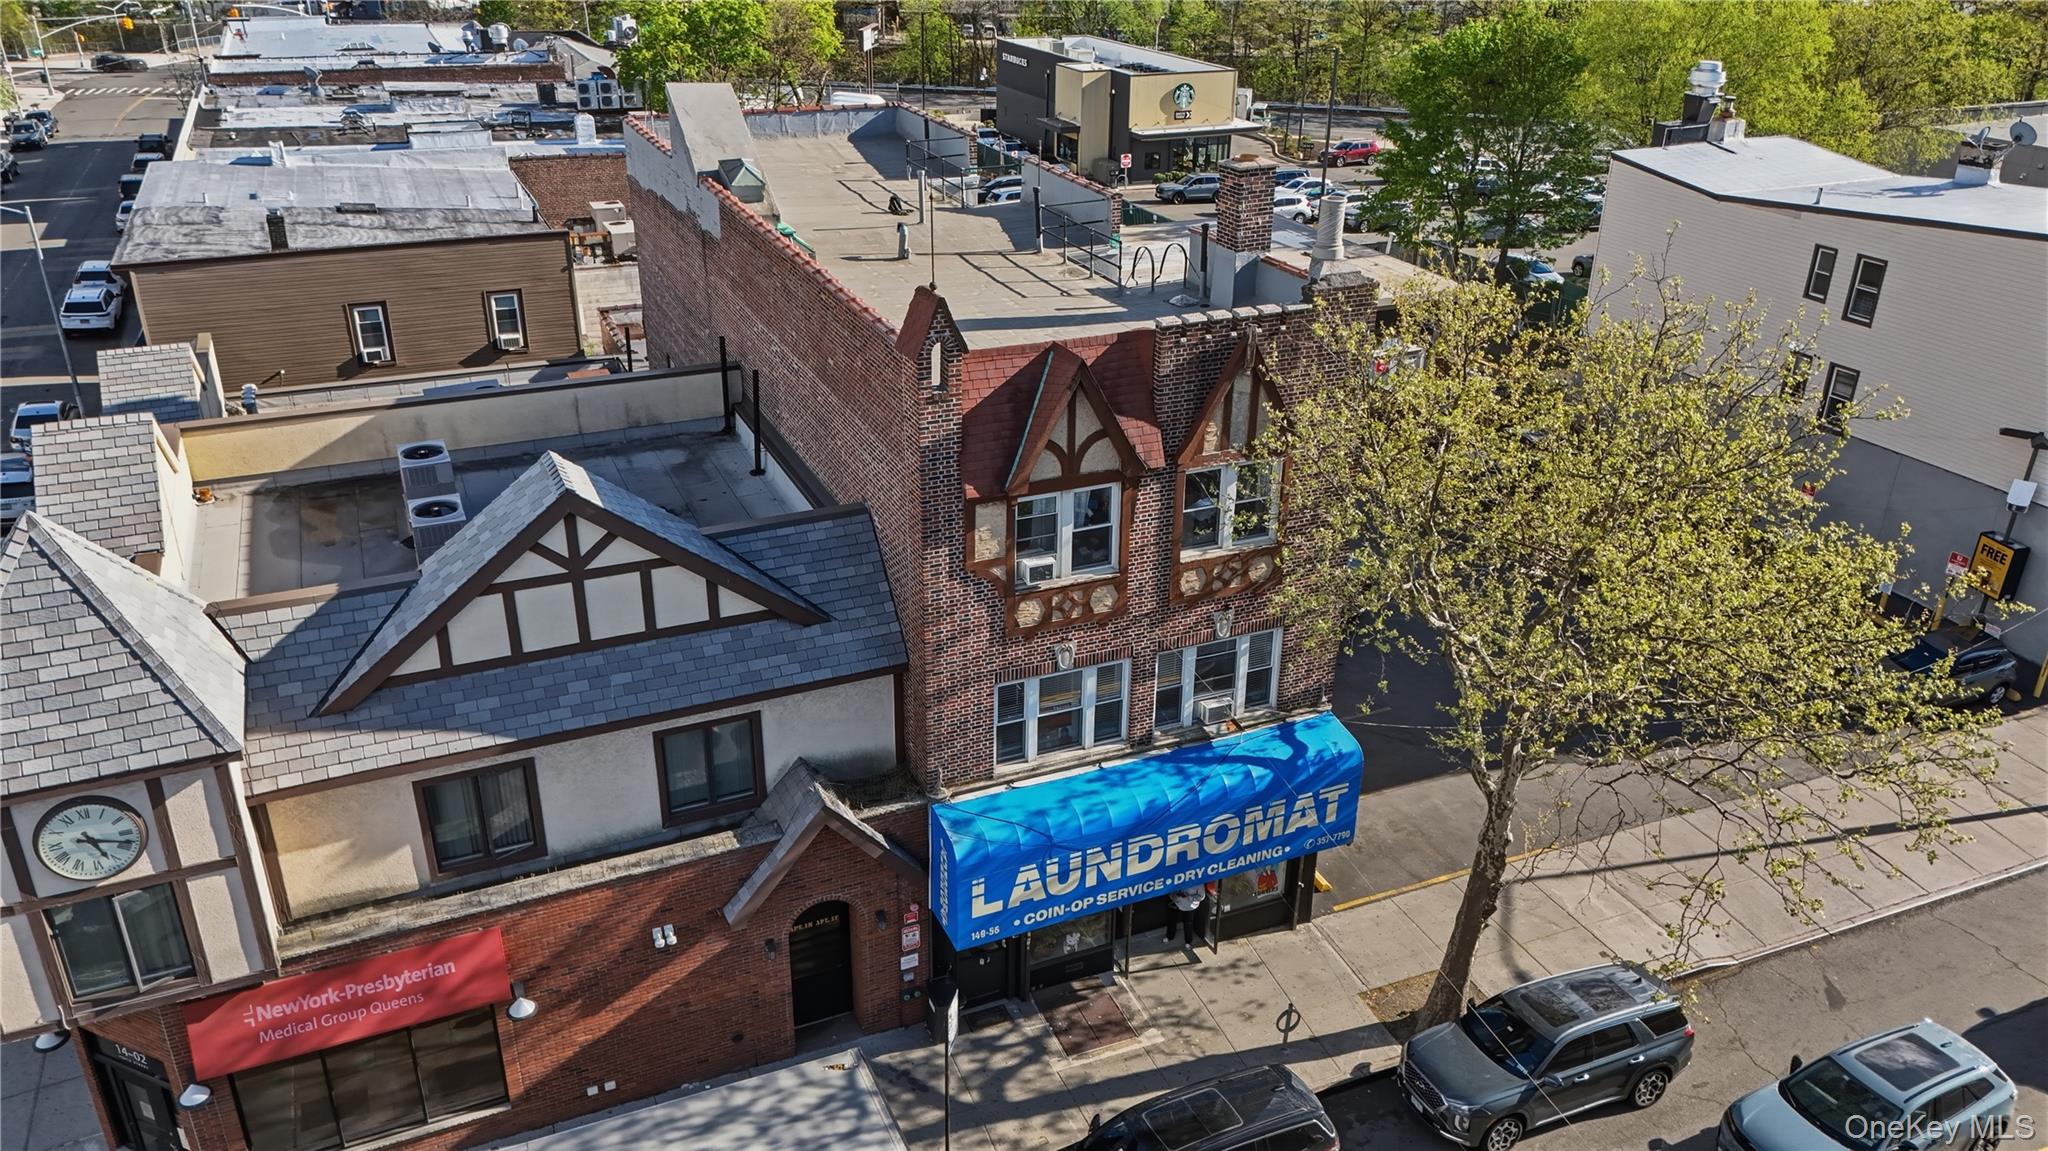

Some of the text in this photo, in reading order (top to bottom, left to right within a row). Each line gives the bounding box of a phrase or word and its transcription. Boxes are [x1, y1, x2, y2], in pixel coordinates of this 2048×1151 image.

[1002, 52, 1028, 67] STARBUCKS
[1980, 543, 2008, 566] FREE
[971, 783, 1349, 919] LAUNDROMAT
[1023, 847, 1283, 926] COIN-OP SERVICE DRY CLEANING
[256, 960, 456, 1021] NewYork-Presbyterian
[259, 992, 425, 1044] Medical Group Queens
